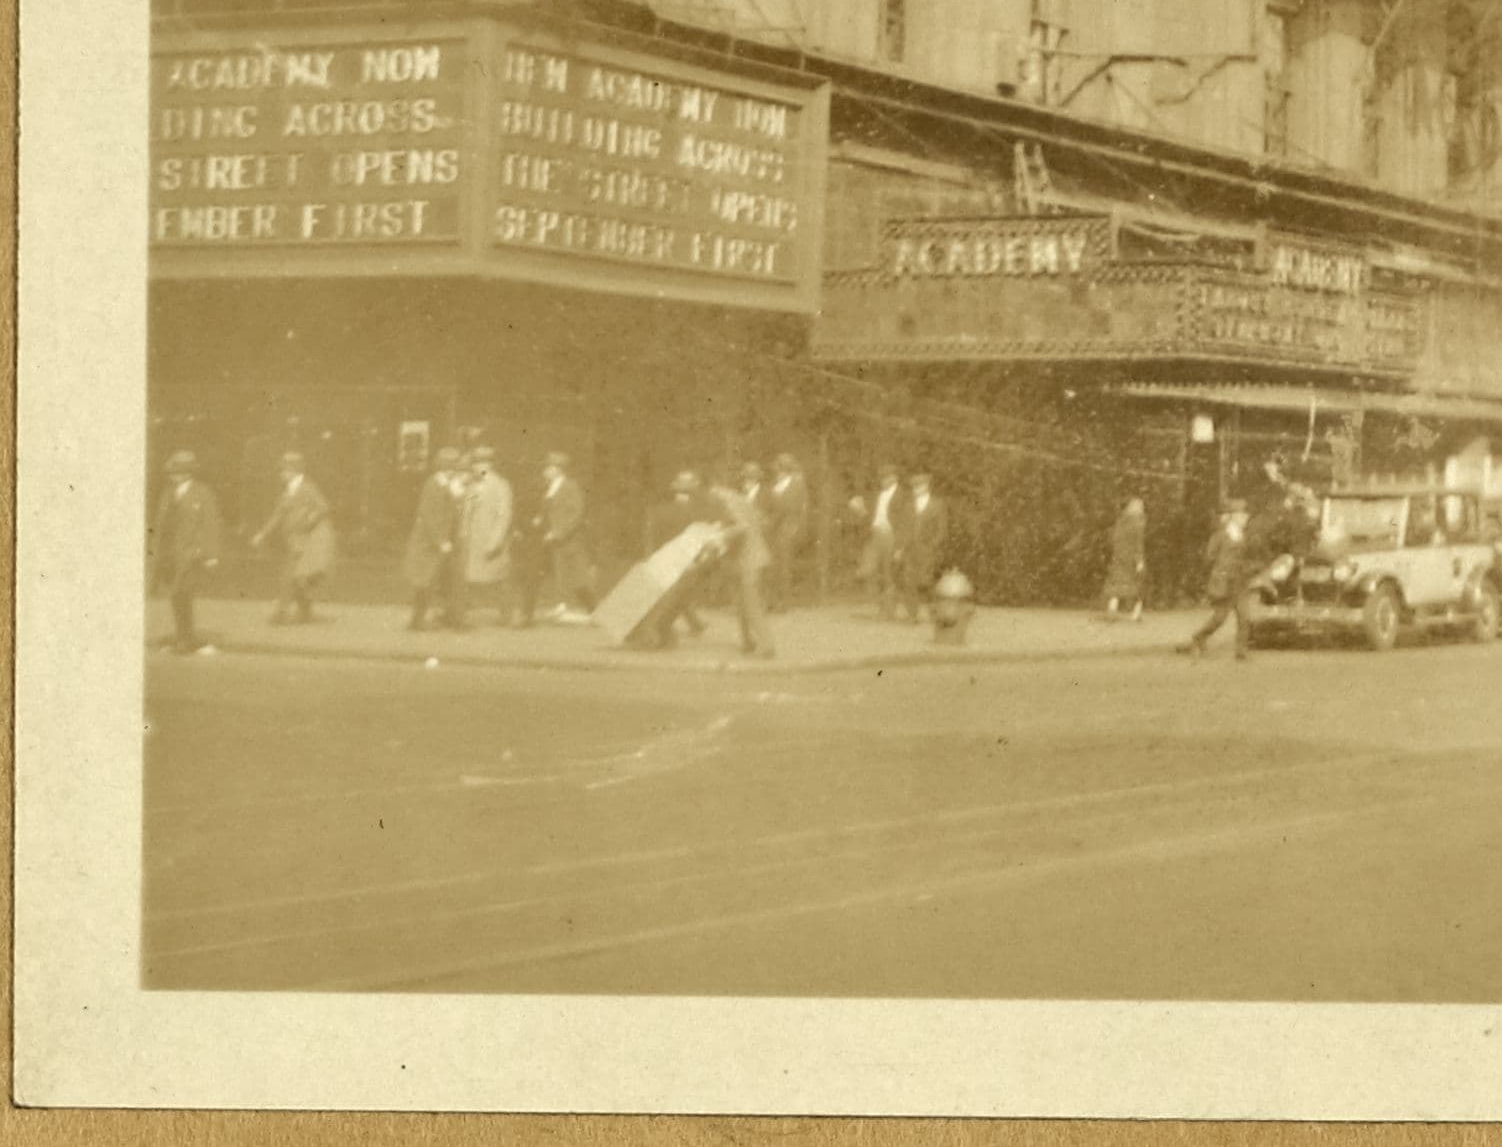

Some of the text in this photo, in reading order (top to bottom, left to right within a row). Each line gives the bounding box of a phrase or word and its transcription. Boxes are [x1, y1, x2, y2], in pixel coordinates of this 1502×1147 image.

[167, 45, 441, 92] ACADEMY NOW
[283, 97, 438, 138] ACROSS
[587, 66, 719, 124] ACADEMY
[500, 101, 786, 183] BUILDING ACROSS
[157, 148, 460, 192] STREET OPENS
[300, 199, 430, 241] FIRST
[494, 204, 781, 276] SEPTEMBER FIRST
[895, 233, 1088, 276] ACADEMY
